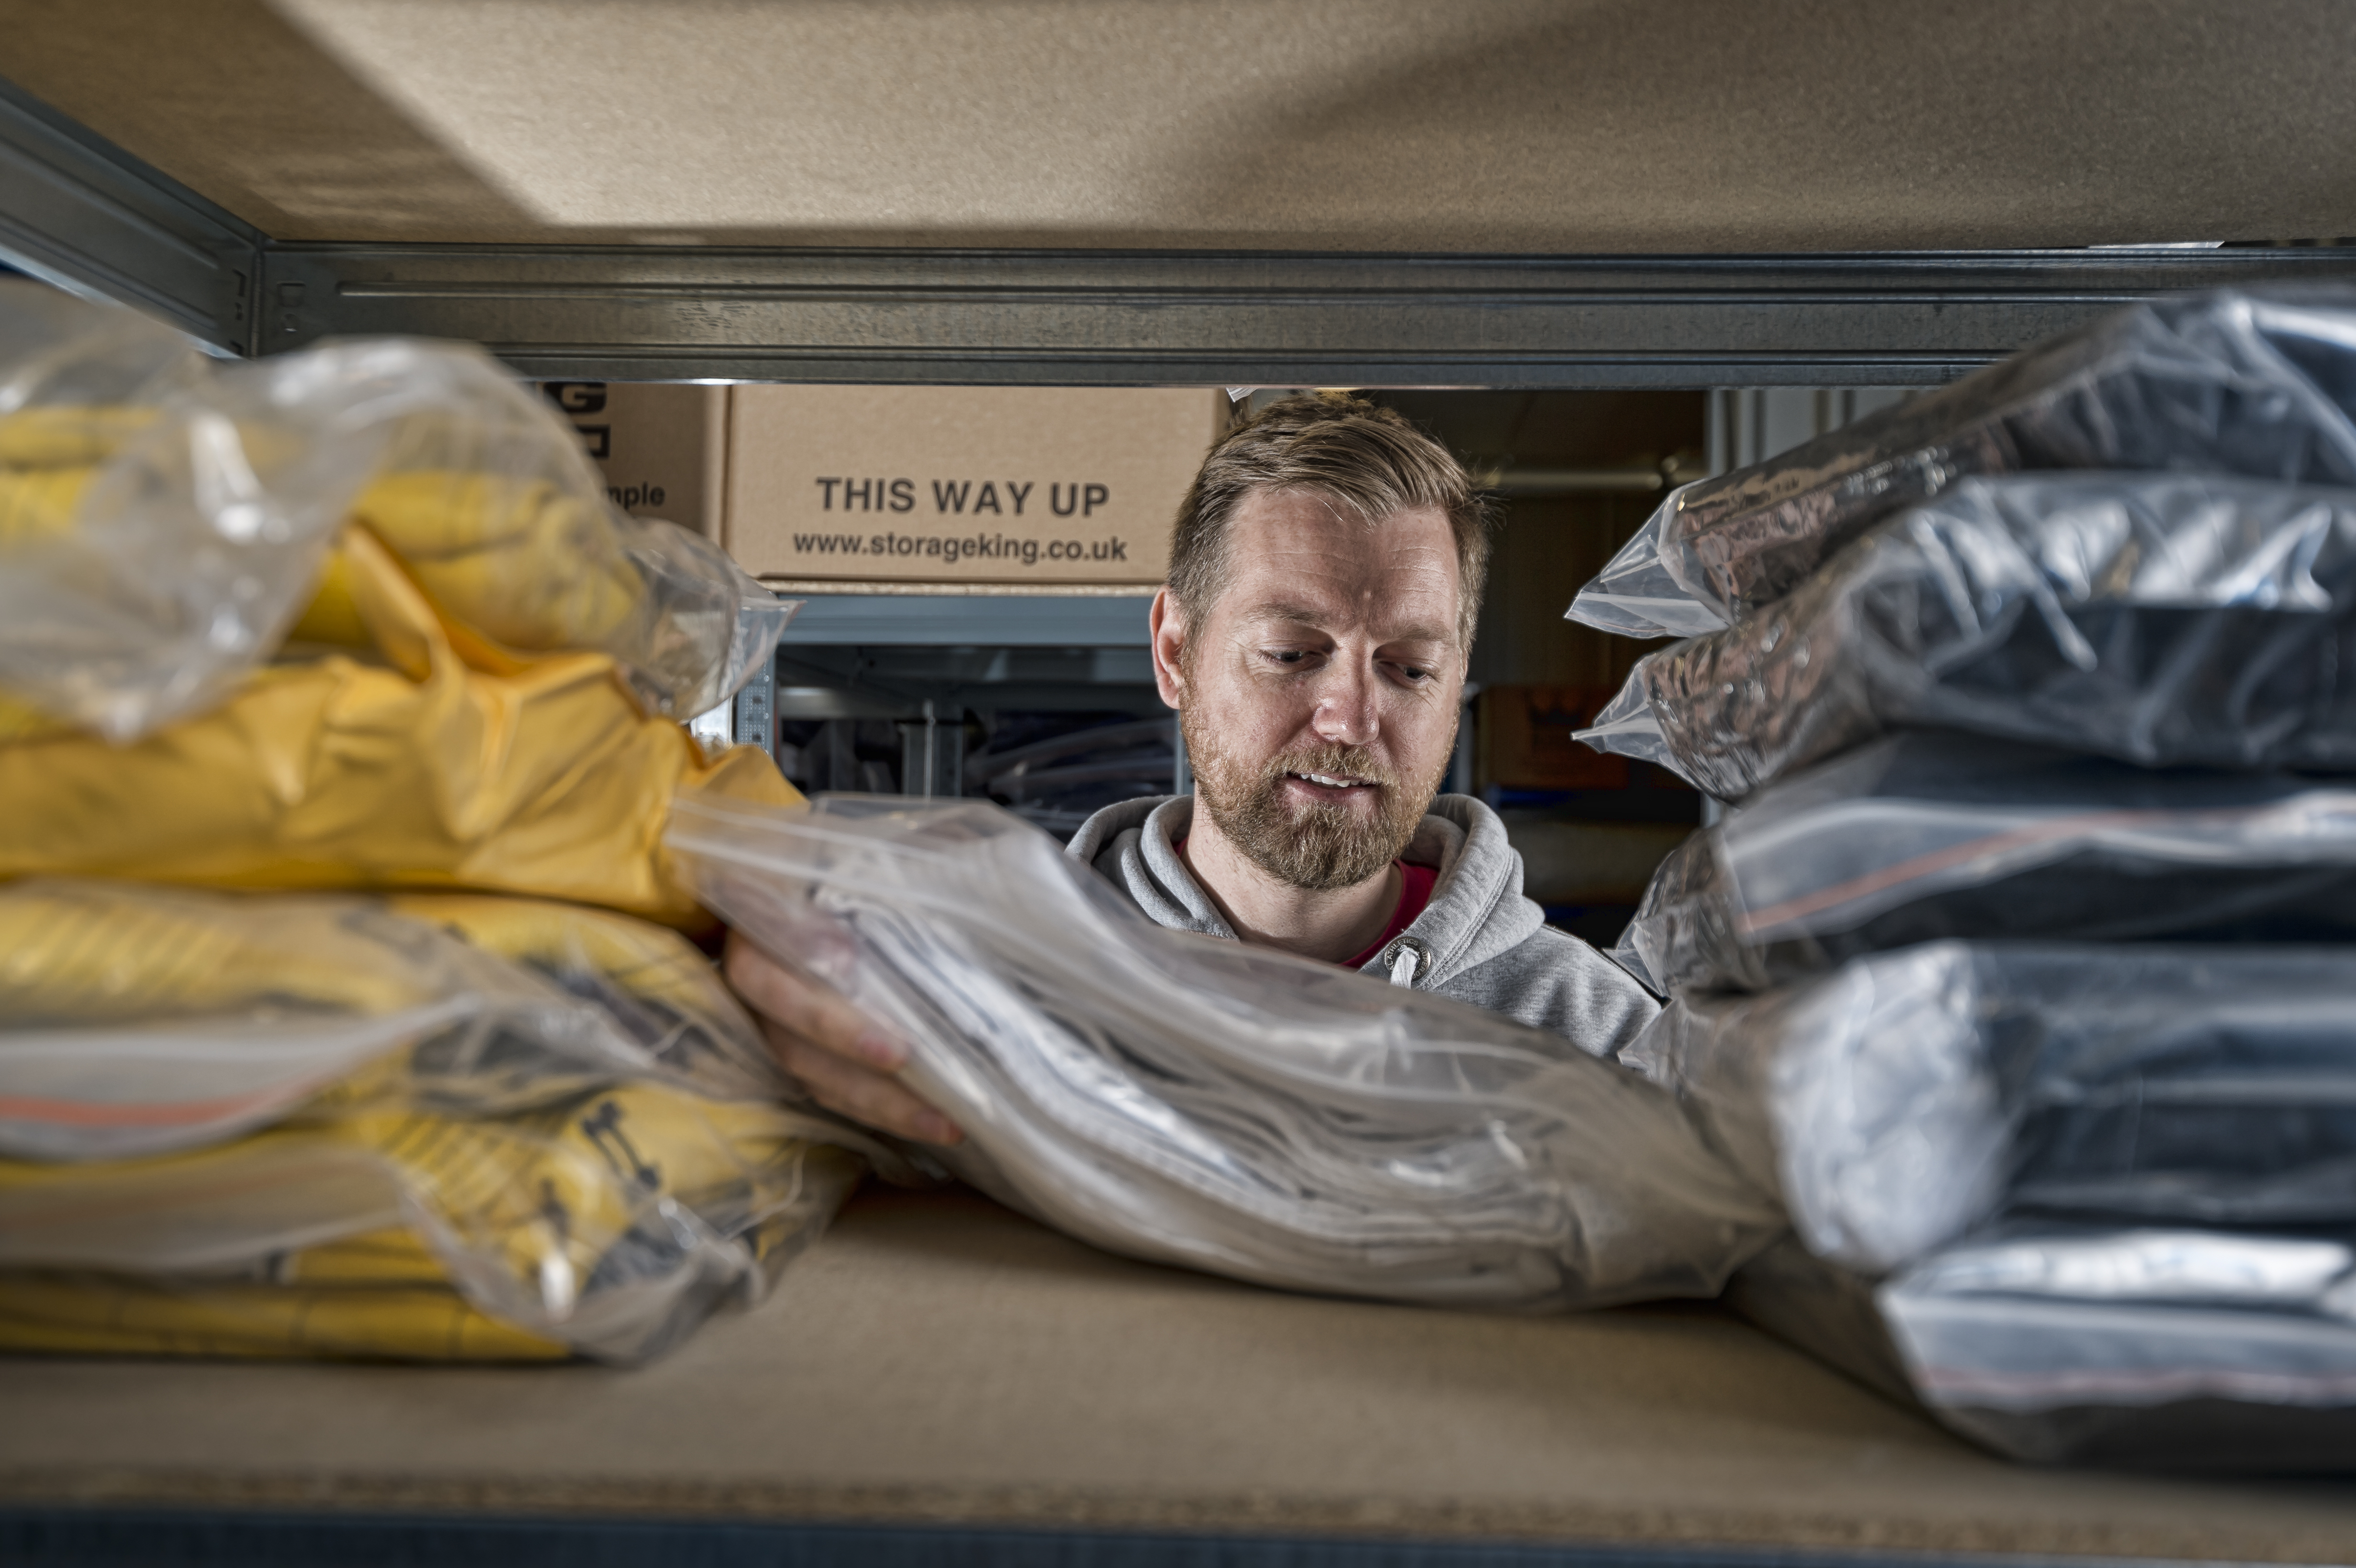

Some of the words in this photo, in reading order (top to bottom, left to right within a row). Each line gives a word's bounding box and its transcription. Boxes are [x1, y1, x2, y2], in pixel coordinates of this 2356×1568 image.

[816, 477, 916, 514] THIS
[932, 479, 1034, 516] WAY
[1050, 482, 1110, 517] UP
[793, 532, 1127, 566] www.storageking.co.uk
[1387, 938, 1418, 960] ATHLETICS
